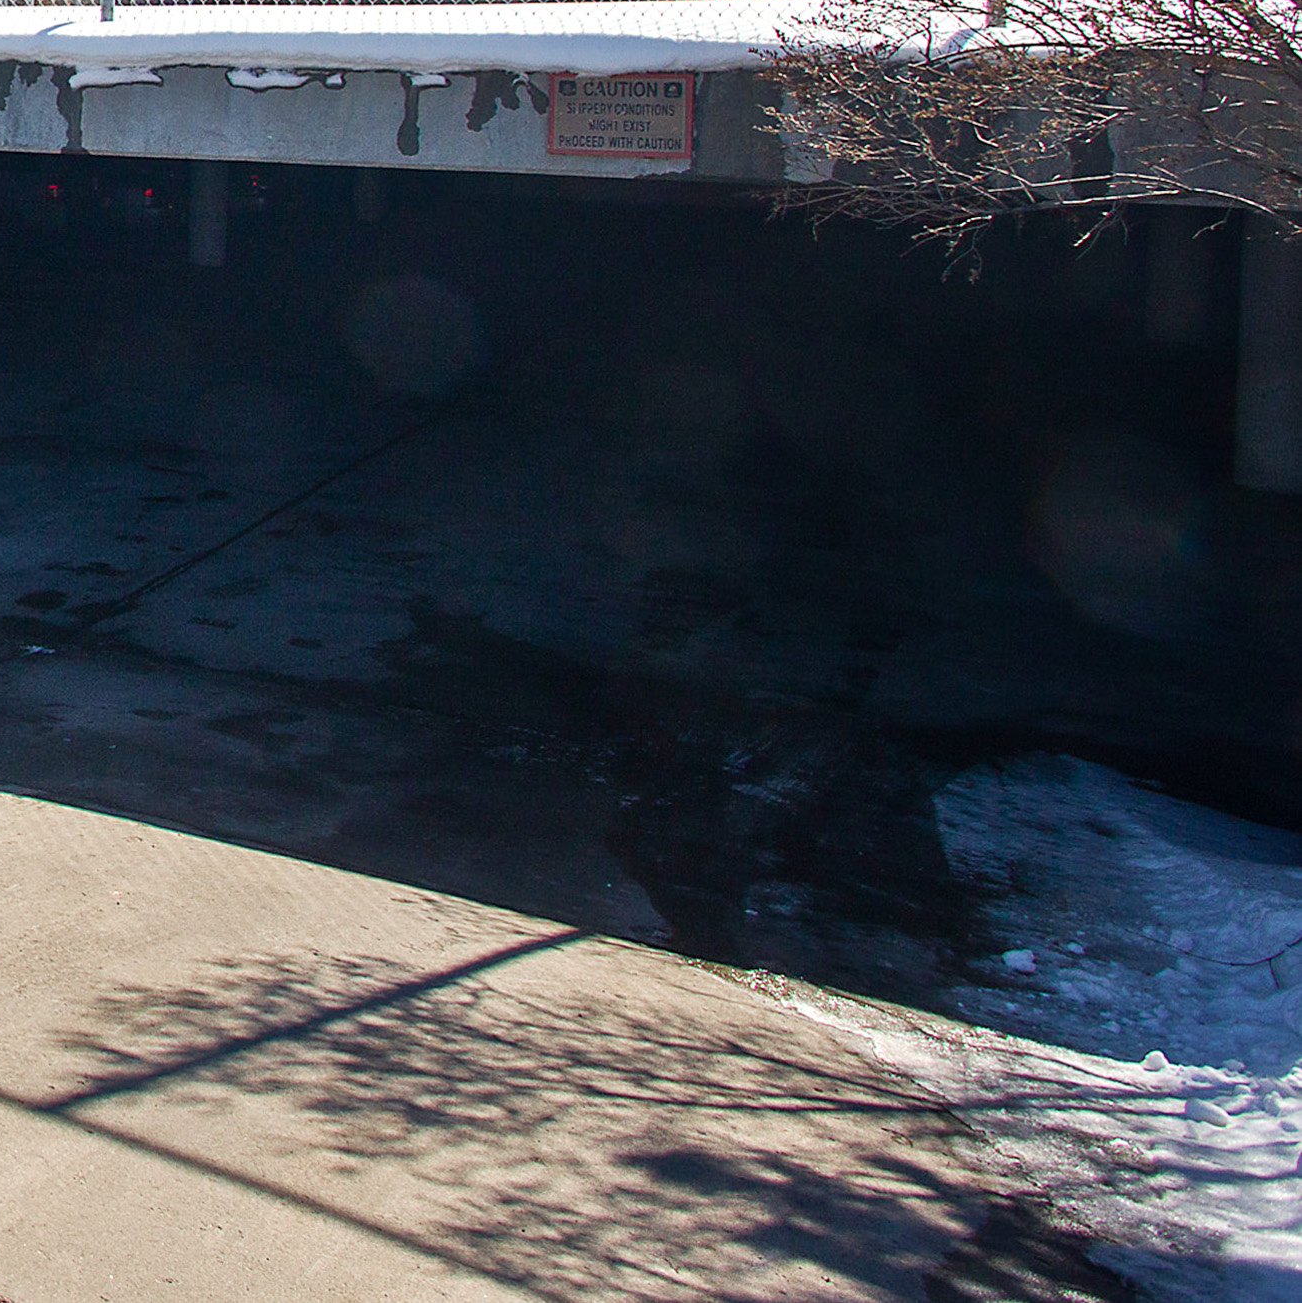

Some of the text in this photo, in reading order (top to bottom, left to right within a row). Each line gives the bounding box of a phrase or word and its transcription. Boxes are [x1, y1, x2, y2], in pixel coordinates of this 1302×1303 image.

[583, 81, 658, 98] CAUTION
[614, 103, 675, 116] CONDITIONS
[623, 120, 652, 132] EXIST
[558, 135, 682, 150] PROCEED WITH CAUTION
